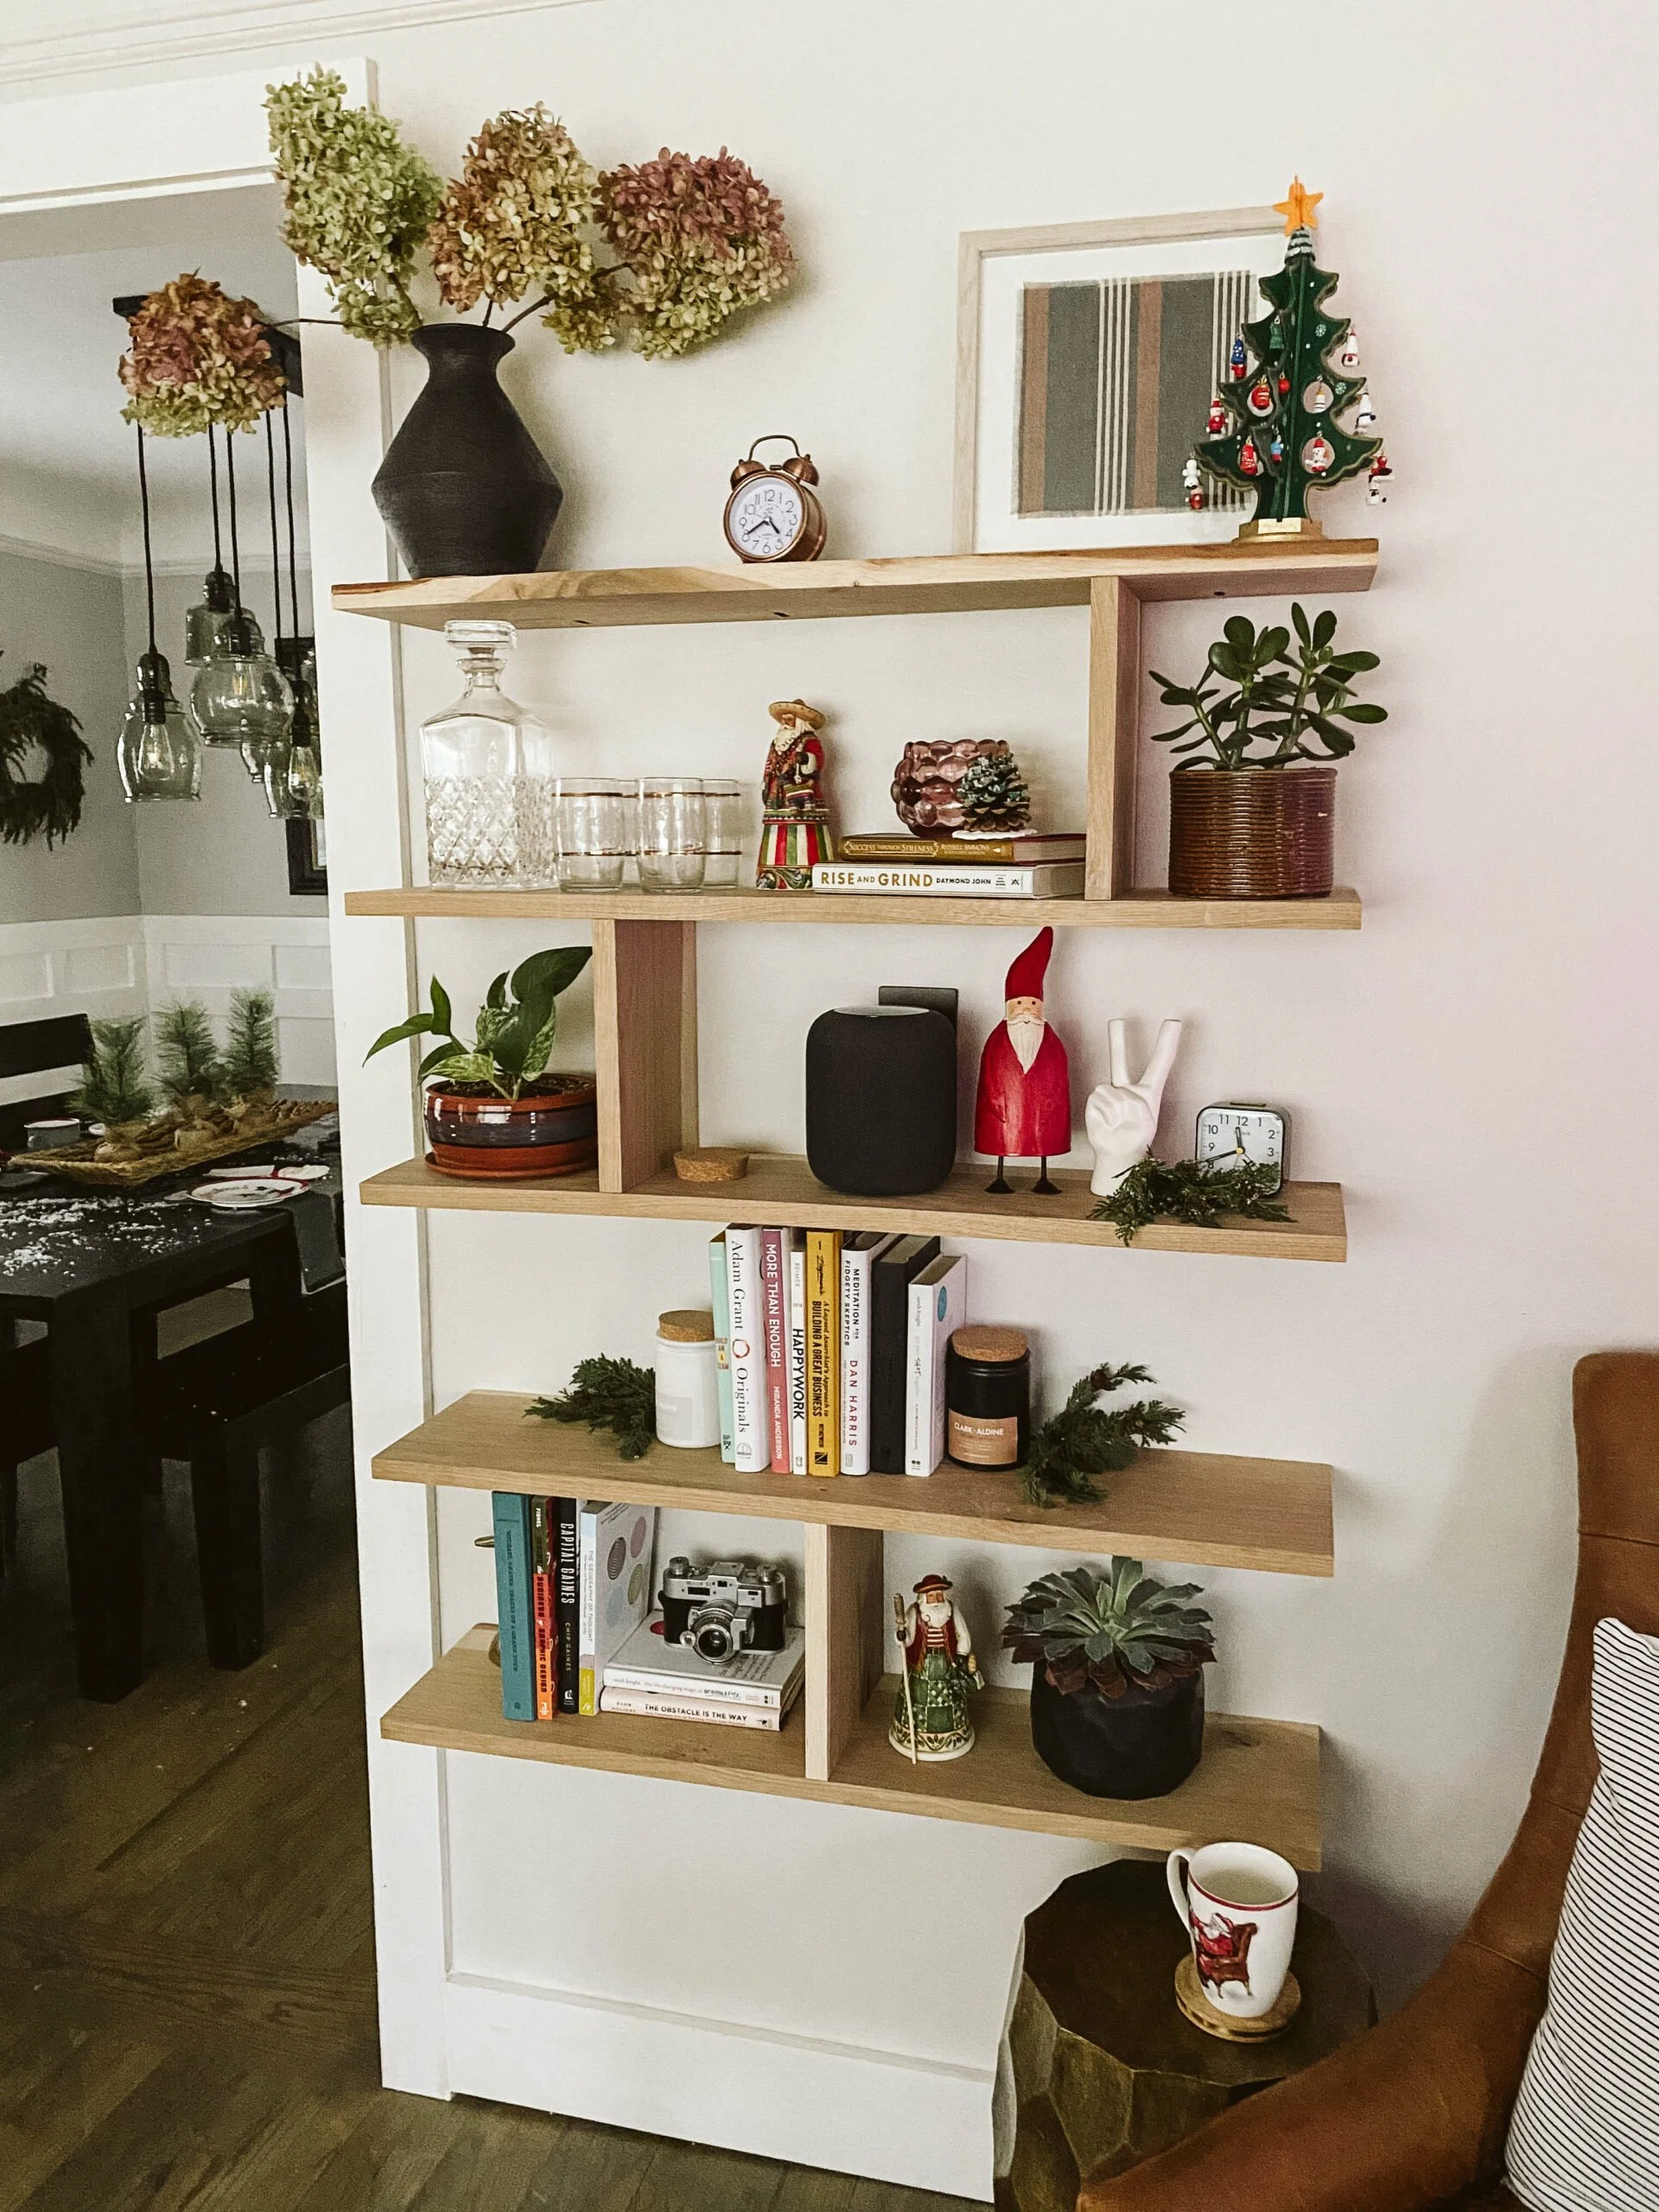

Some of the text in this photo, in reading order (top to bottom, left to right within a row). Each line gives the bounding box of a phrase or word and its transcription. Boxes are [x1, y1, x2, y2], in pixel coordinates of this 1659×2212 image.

[755, 493, 760, 505] 11
[765, 489, 775, 502] 12
[744, 504, 756, 515] 10
[785, 500, 794, 513] 2
[739, 517, 747, 529] 9
[788, 514, 798, 526] 3
[742, 529, 750, 542] 8
[785, 529, 793, 539] 4
[752, 540, 760, 551] 7
[763, 542, 771, 554] 6
[775, 539, 784, 550] 5
[821, 872, 855, 885] RISE
[878, 873, 933, 887] GRIND
[1219, 1114, 1229, 1125] 11
[1237, 1116, 1249, 1126] 12
[1208, 1125, 1219, 1135] 10
[1268, 1130, 1275, 1139] 2
[1208, 1142, 1215, 1151] 9
[1268, 1147, 1274, 1157] 3
[1208, 1160, 1214, 1169] 8
[731, 1240, 746, 1329] Adam Grant
[766, 1244, 781, 1367] MORE THAN ENOUGH
[812, 1300, 822, 1340] BUILDING
[813, 1349, 822, 1375] GREAT
[792, 1328, 805, 1420] HAPPYWORK
[735, 1367, 750, 1433] Originals
[813, 1376, 822, 1417] BUSINESS
[849, 1360, 858, 1446] DAN HARRIS
[954, 1422, 973, 1434] CLARK
[774, 1420, 782, 1459] ANDERSON
[560, 1523, 575, 1605] CAPITAL GAINES
[537, 1576, 545, 1618] BUSINESS
[588, 1603, 594, 1611] OF
[645, 1703, 659, 1712] THE
[661, 1706, 700, 1716] OBSTACLE
